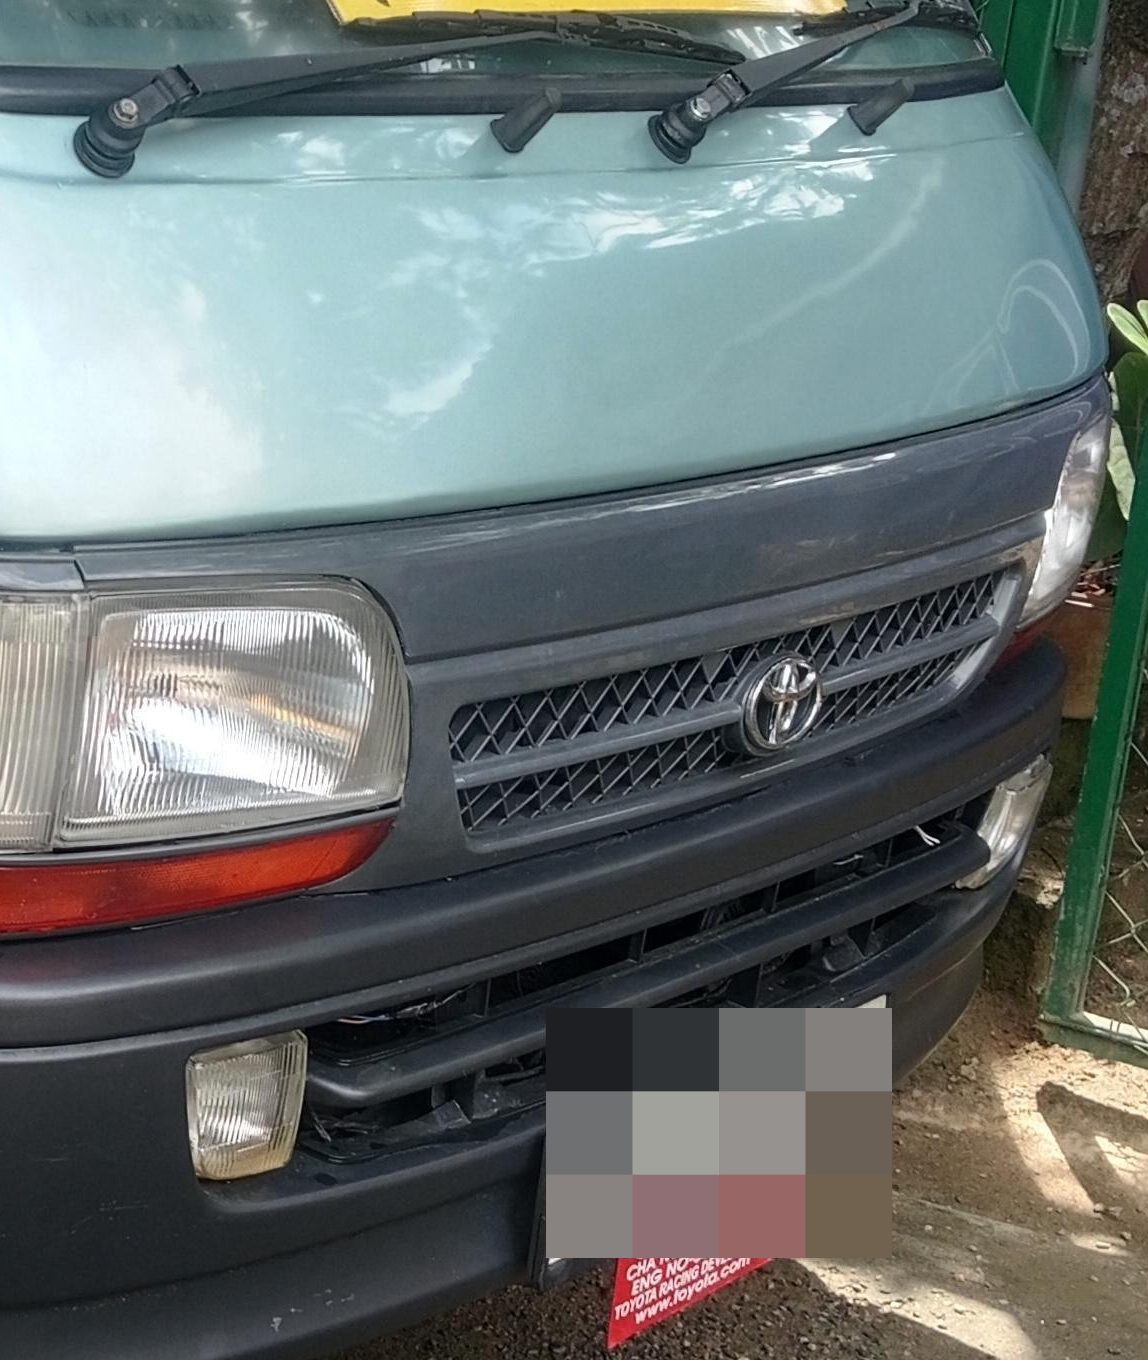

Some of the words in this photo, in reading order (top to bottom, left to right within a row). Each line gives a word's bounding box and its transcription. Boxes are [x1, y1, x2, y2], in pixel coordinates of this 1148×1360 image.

[614, 1287, 658, 1321] TOYOTA
[658, 1264, 700, 1298] RACING
[631, 1269, 663, 1296] ENG
[634, 1258, 751, 1325] www.toyota.com
